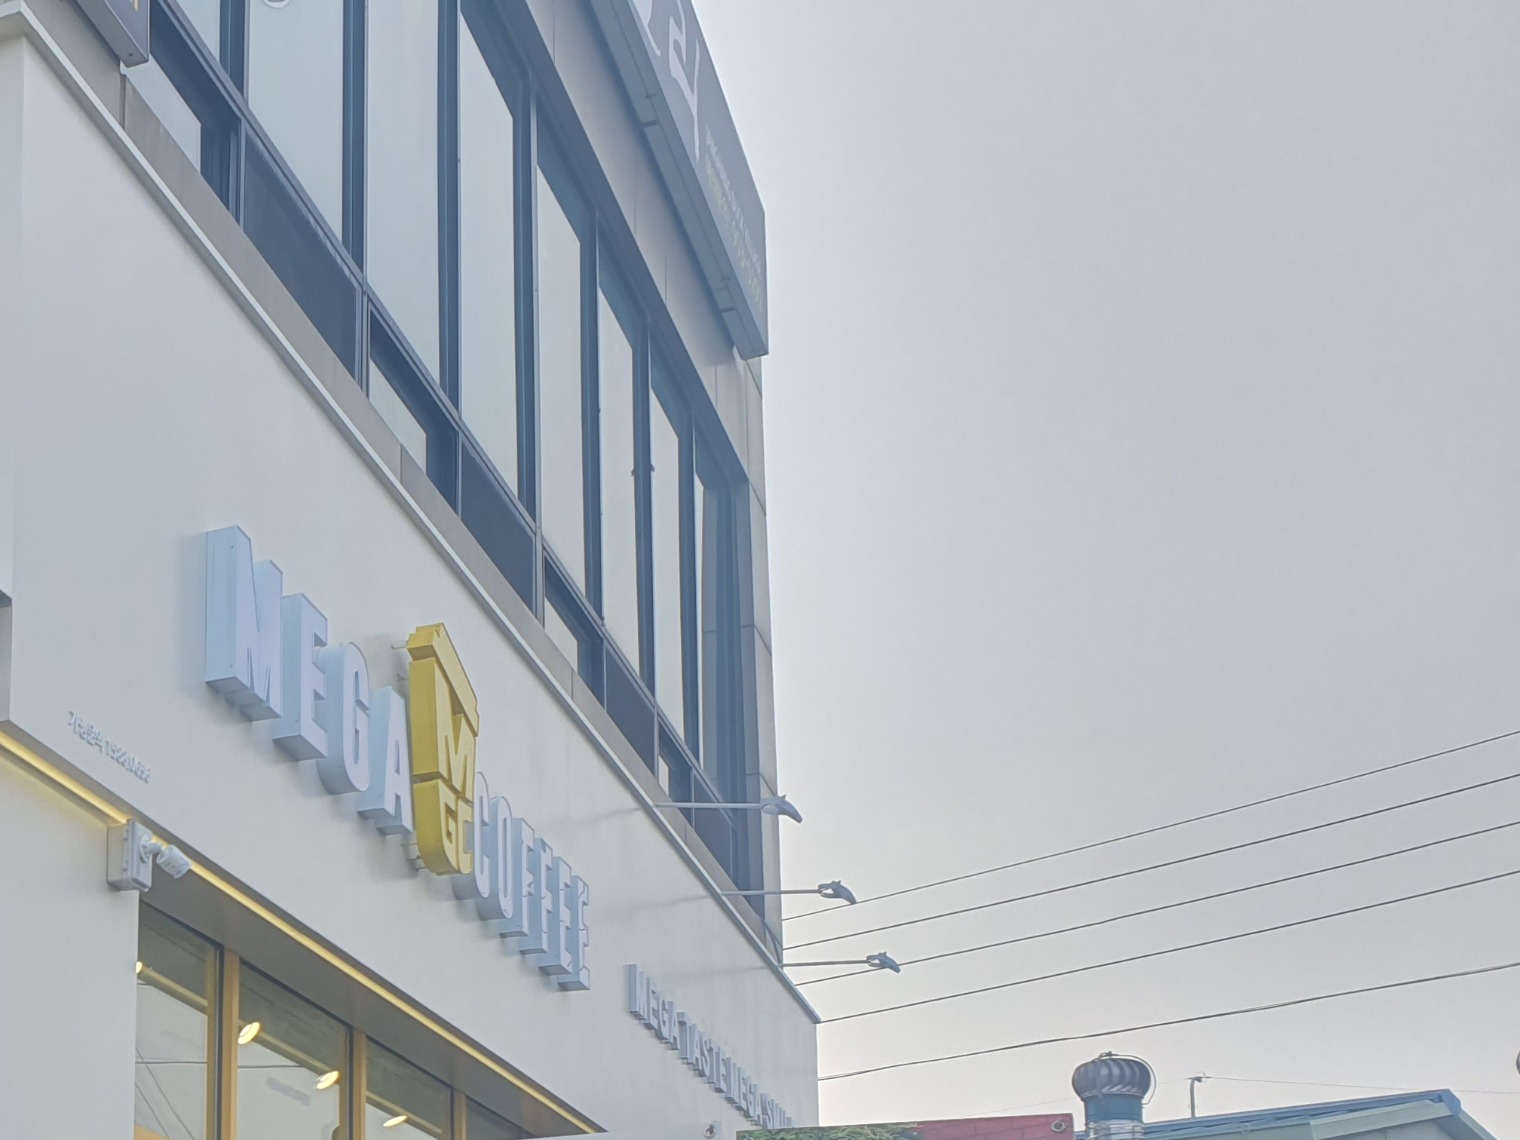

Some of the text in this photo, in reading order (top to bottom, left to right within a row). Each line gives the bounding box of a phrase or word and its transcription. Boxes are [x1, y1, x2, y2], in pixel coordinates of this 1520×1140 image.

[205, 525, 590, 991] MEGA COFFEE
[627, 964, 680, 1051] MEGA
